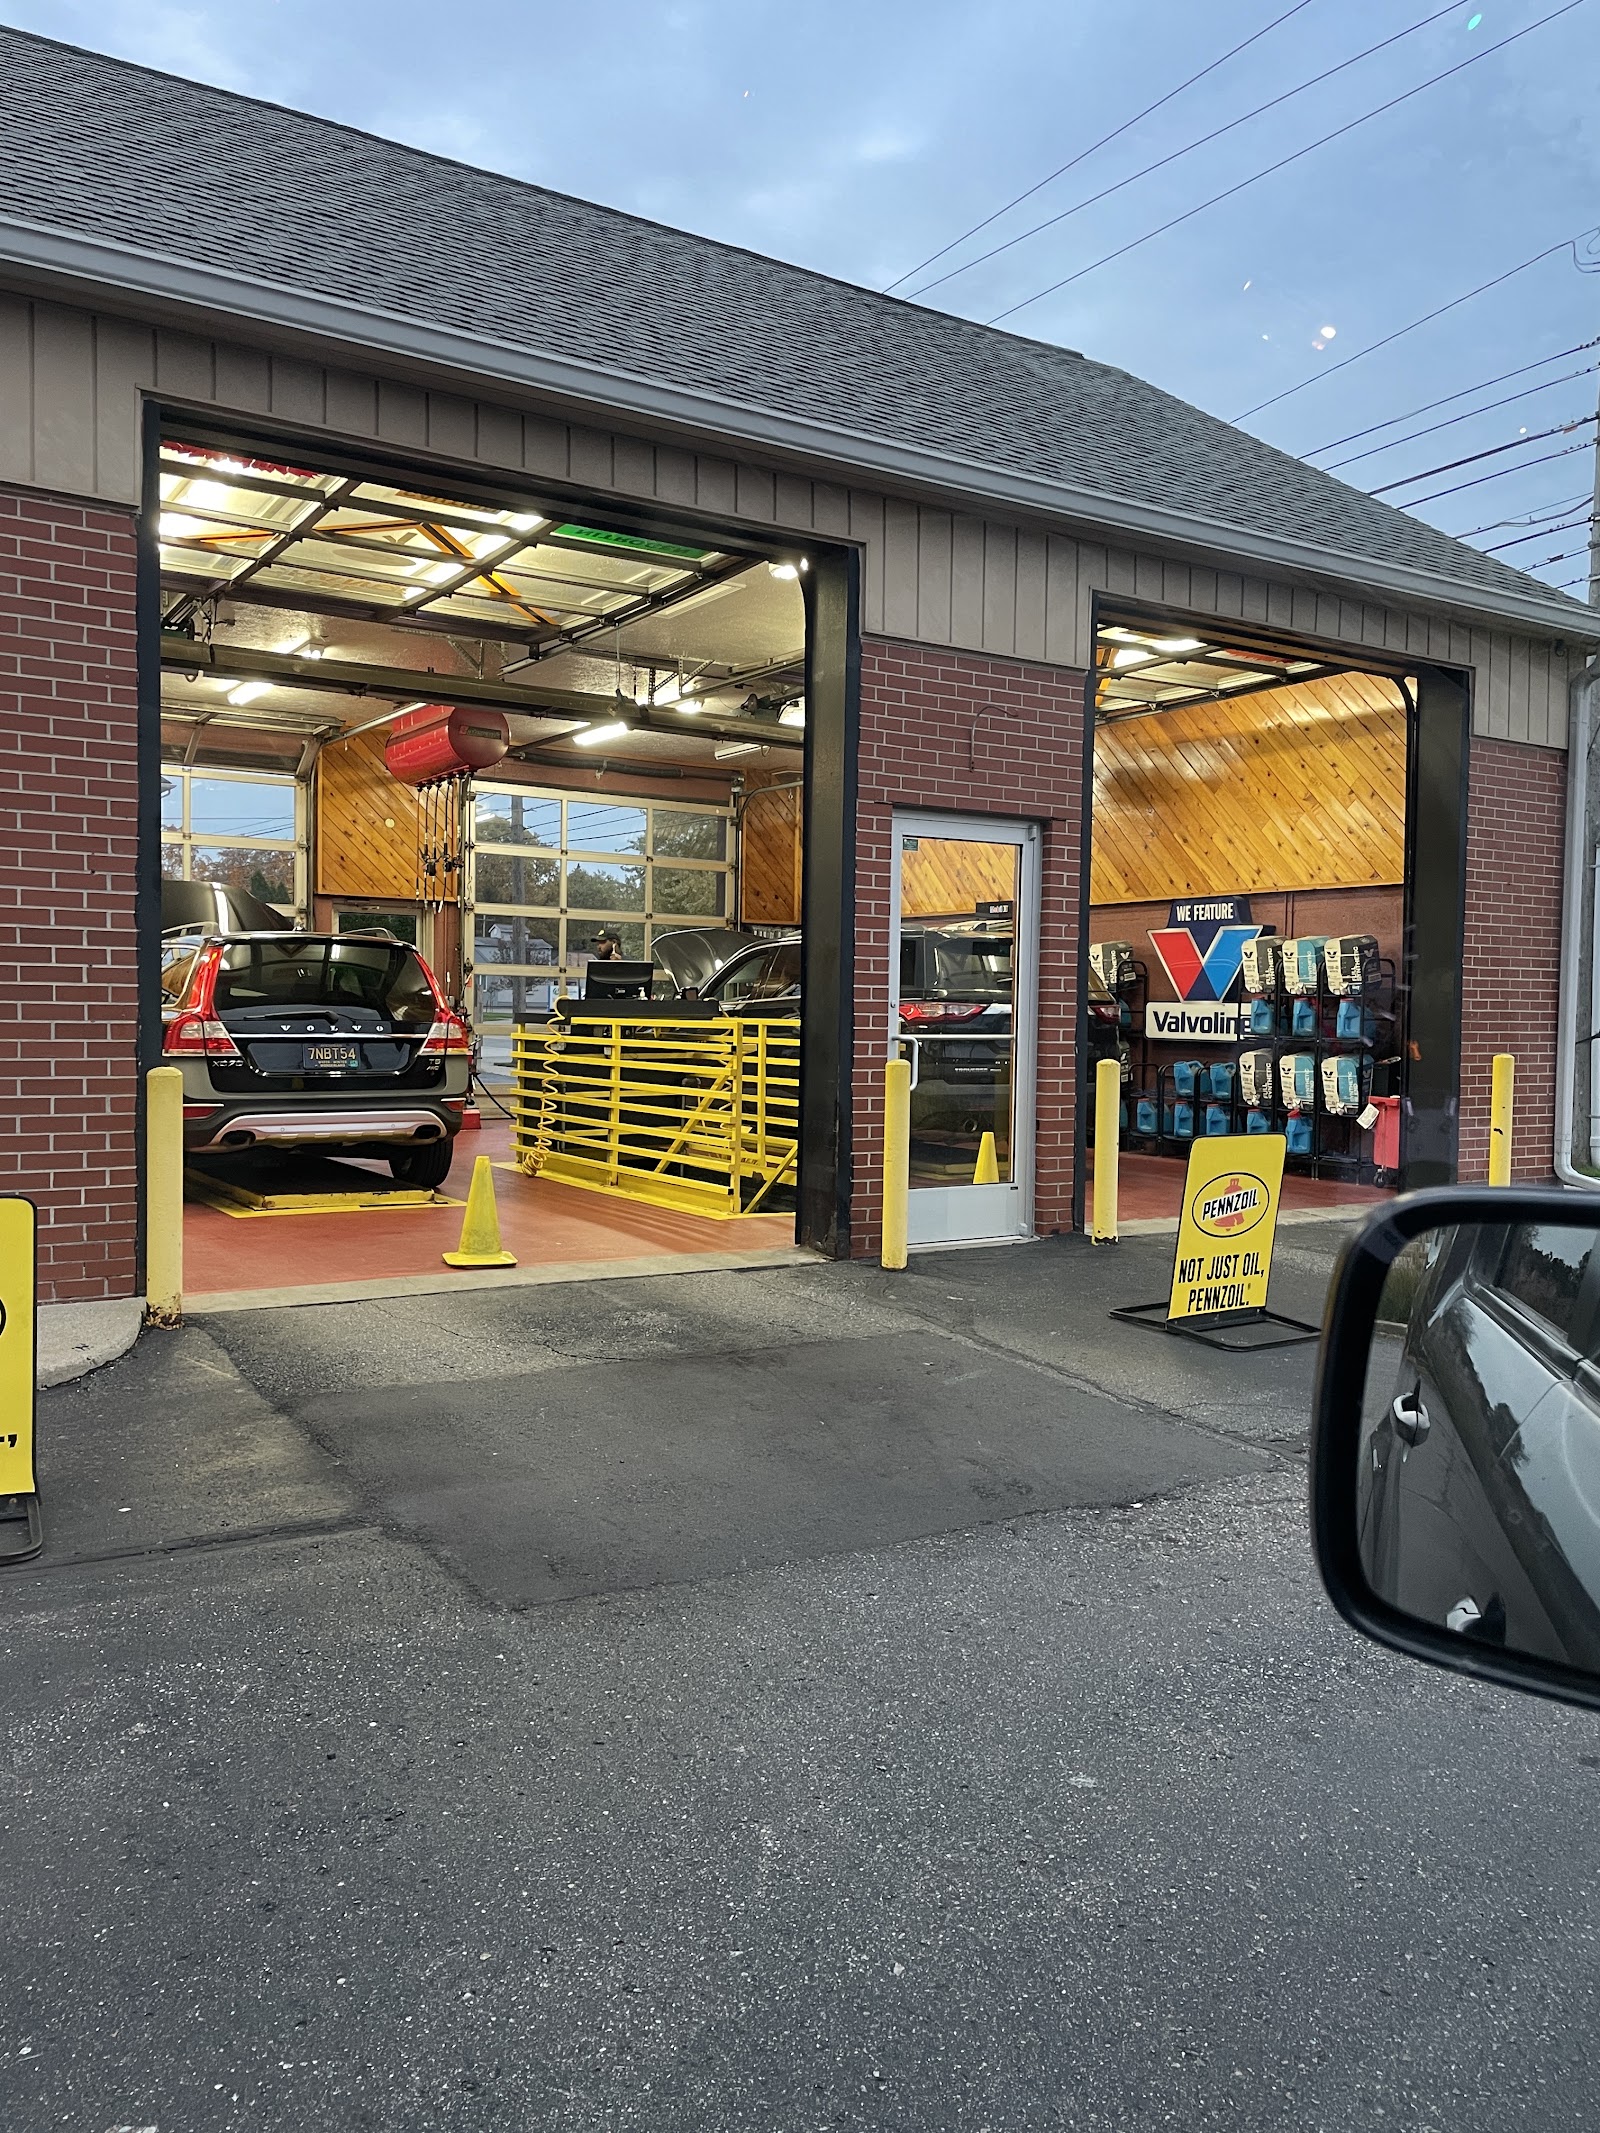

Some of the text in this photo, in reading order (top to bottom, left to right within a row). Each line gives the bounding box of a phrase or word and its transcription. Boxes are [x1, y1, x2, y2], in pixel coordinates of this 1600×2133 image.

[1176, 903, 1234, 921] WE FEATURE
[308, 1047, 356, 1060] 7NBT54
[1202, 1189, 1258, 1221] PENNZOIL
[1178, 1252, 1264, 1284] NOT JUST OIL,
